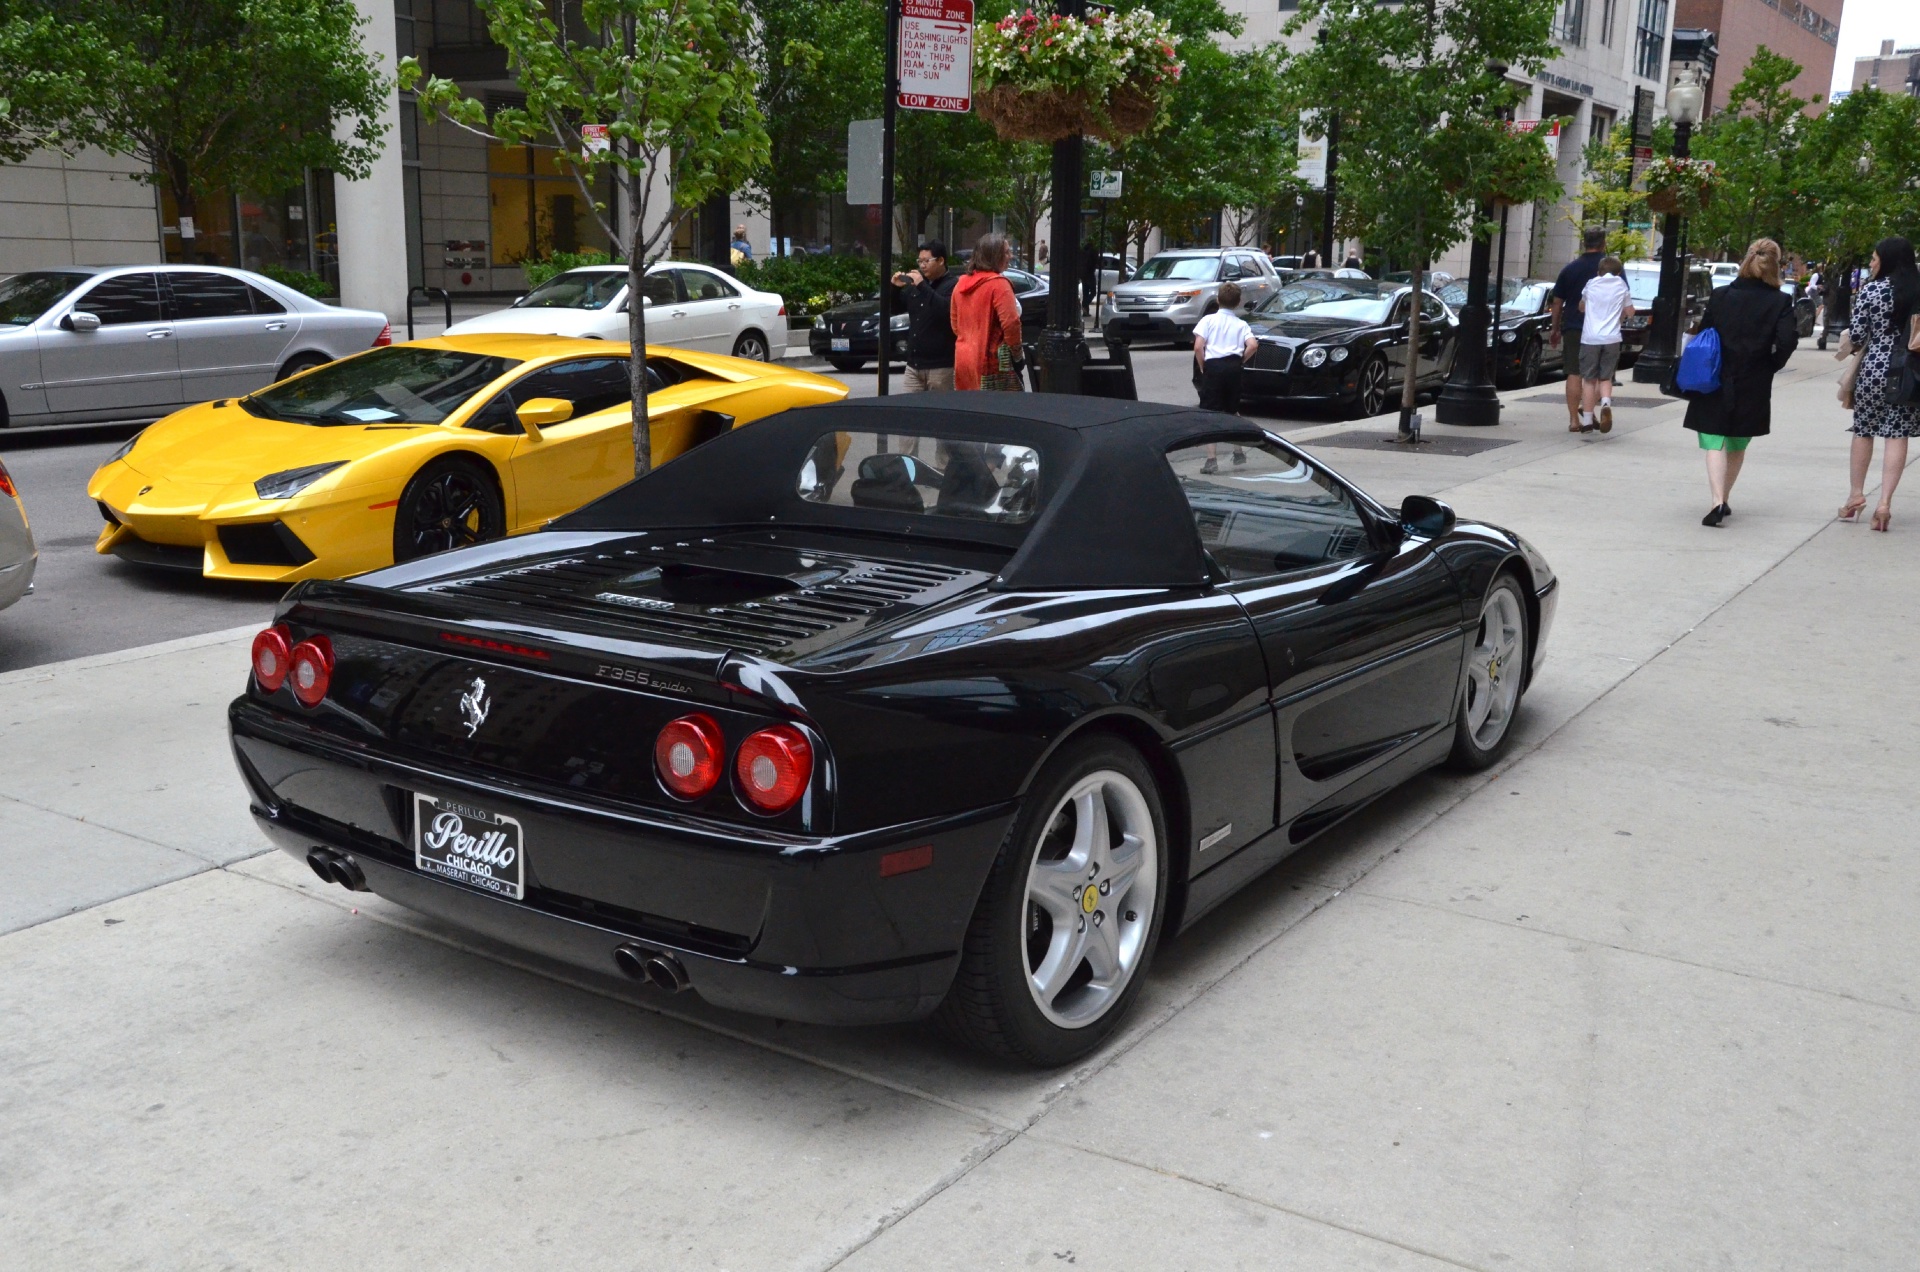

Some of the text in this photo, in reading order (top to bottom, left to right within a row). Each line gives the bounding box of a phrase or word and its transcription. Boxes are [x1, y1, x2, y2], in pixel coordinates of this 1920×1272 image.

[916, 0, 943, 8] MINUTE
[905, 6, 965, 20] STANDING ZONE
[904, 21, 919, 30] USE
[904, 31, 968, 45] FLASHING LIGHTS
[904, 40, 912, 49] 10
[913, 41, 925, 50] AM
[933, 43, 938, 51] 8
[940, 44, 951, 52] PM
[904, 50, 921, 59] MON
[930, 52, 955, 62] THURS
[904, 60, 911, 68] 10
[912, 60, 924, 69] AM
[932, 62, 937, 70] 6
[939, 63, 951, 71] PM
[903, 69, 916, 78] FRI
[923, 71, 940, 80] SUN
[903, 95, 964, 110] TOW ZONE
[595, 664, 693, 693] F355 spider
[446, 801, 486, 820] PERILLO
[424, 812, 516, 869] Perillo
[446, 853, 492, 877] CHICAGO
[436, 864, 468, 881] MASERATI
[470, 874, 500, 891] CHICAGO
